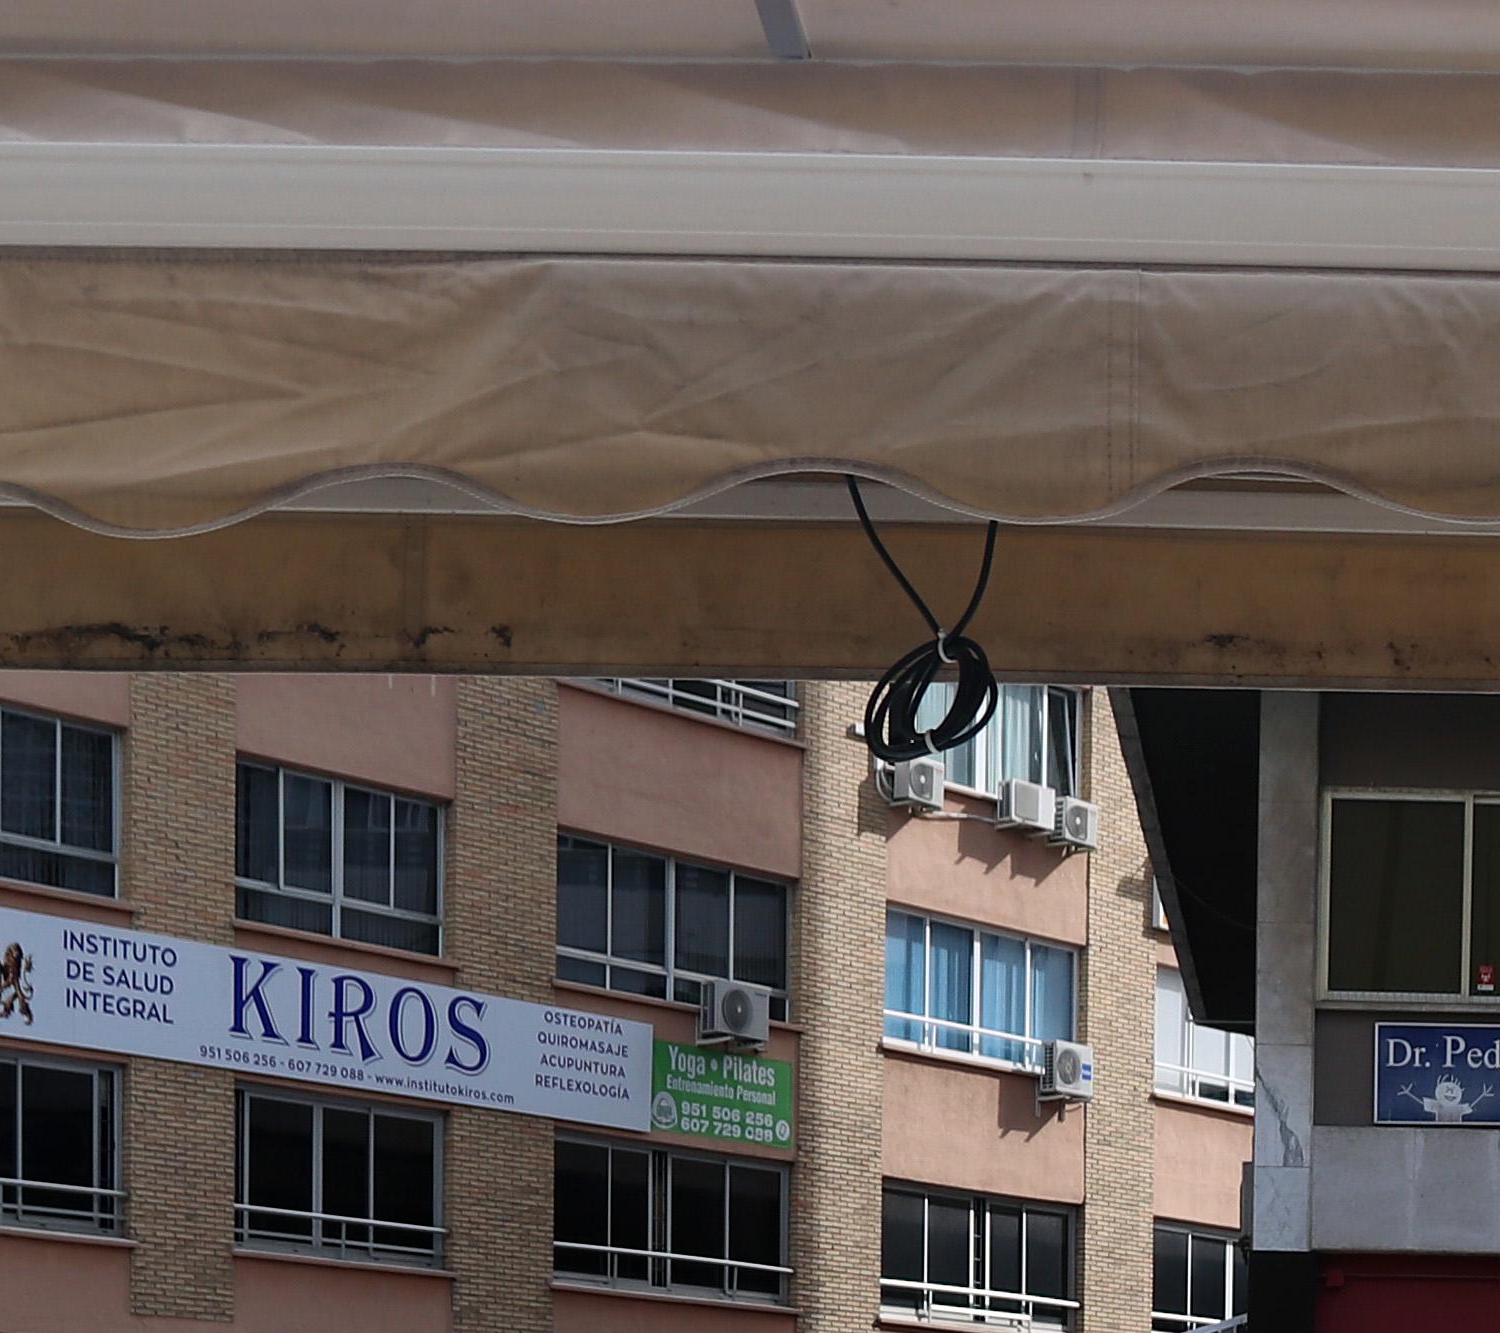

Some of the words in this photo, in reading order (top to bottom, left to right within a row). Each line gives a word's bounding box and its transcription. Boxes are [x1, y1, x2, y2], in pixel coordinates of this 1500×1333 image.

[63, 928, 177, 968] INSTITUTO
[67, 959, 94, 983] DE
[102, 965, 174, 995] SALUD
[66, 988, 174, 1024] INTEGRAL
[228, 953, 491, 1076] KIROS
[544, 1010, 623, 1036] OSTEOPATÍA
[537, 1032, 629, 1058] QUIROMASAJE
[1385, 1038, 1431, 1069] Dr.
[200, 1045, 221, 1060] 951
[225, 1048, 250, 1064] 506
[253, 1053, 277, 1068] 256
[288, 1058, 312, 1074] 607
[315, 1062, 338, 1077] 729
[341, 1065, 365, 1081] 088
[375, 1073, 515, 1105] www.institutokiros.com
[540, 1054, 626, 1078] ACUPUNTURA
[668, 1045, 706, 1080] Yoga
[722, 1057, 776, 1087] Pilates
[534, 1073, 630, 1100] REFLEXOLOGÍA
[666, 1074, 735, 1099] Entrenamiento
[736, 1085, 776, 1106] Personal
[680, 1116, 708, 1133] 607
[713, 1120, 741, 1138] 729
[745, 1125, 773, 1143] 088
[681, 1101, 708, 1118] 951
[712, 1105, 740, 1123] 506
[745, 1110, 773, 1127] 256
